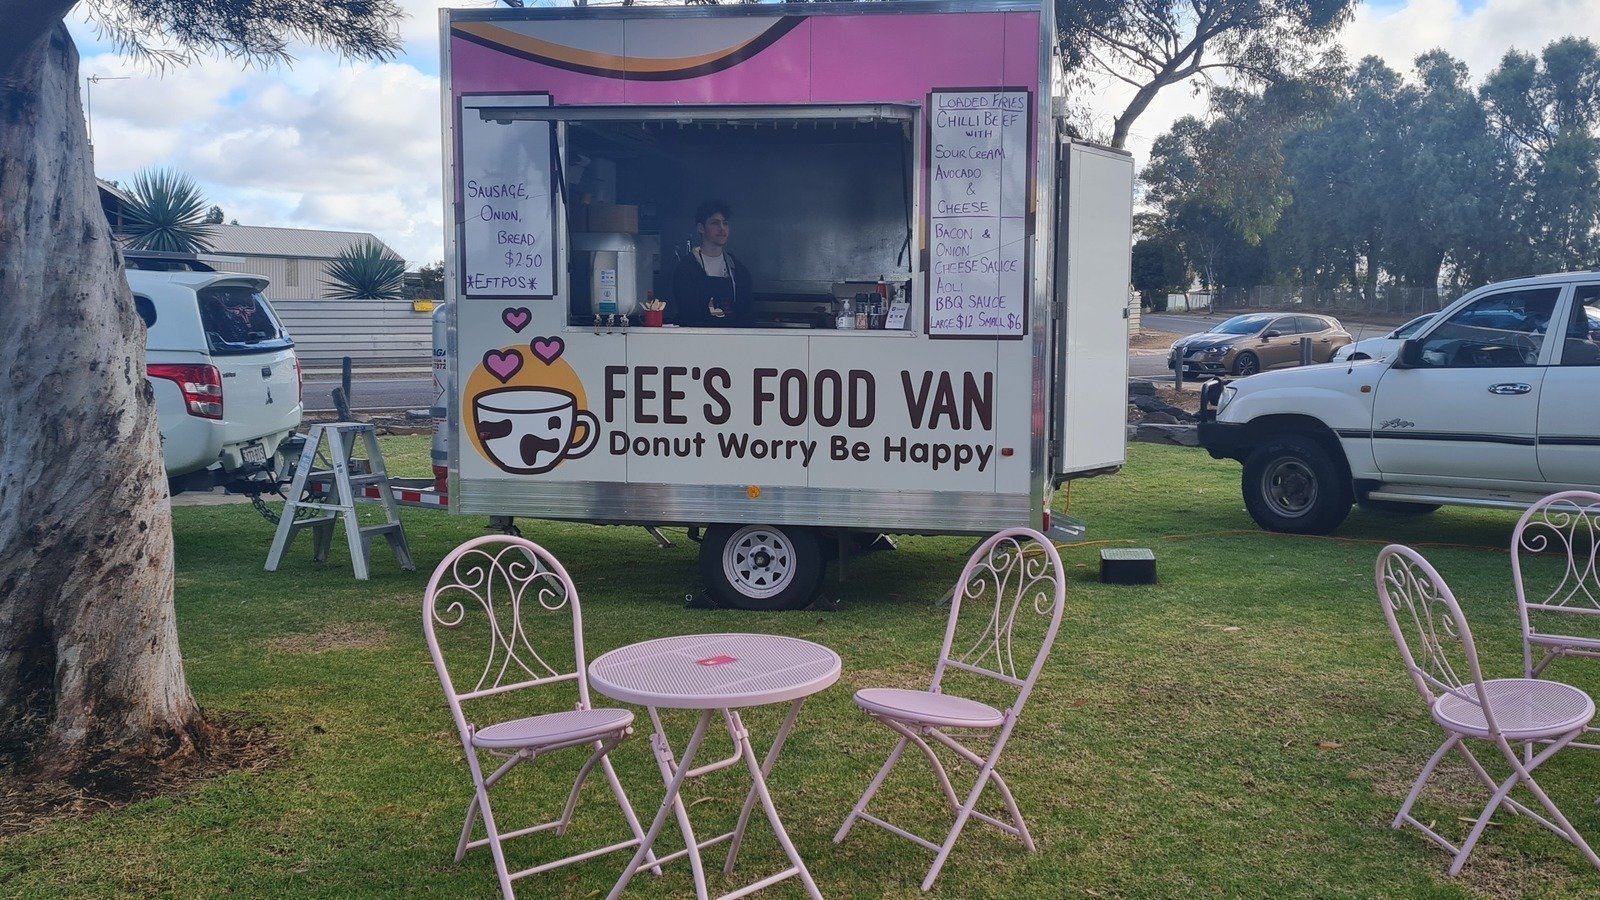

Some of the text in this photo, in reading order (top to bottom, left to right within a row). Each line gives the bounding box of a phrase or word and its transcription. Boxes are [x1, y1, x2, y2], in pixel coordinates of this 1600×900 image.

[939, 93, 1024, 109] LOADED FRIES
[937, 110, 1019, 128] CHILLI BEEF
[965, 130, 992, 138] WITH
[935, 144, 1005, 159] SOUR CREAM
[935, 164, 982, 181] AVOCADO
[467, 180, 530, 200] SAUSAGE,
[966, 182, 976, 195] &
[480, 204, 522, 222] ONION,
[938, 200, 989, 214] CHEESE
[497, 230, 535, 246] BREAD
[935, 223, 991, 239] BACON &
[936, 242, 970, 257] ONION
[504, 250, 543, 268] $2.50
[934, 256, 1018, 275] CHEESE SAUCE
[936, 277, 963, 294] AOLI
[935, 294, 1007, 311] BBQ SAUCE
[930, 311, 1022, 330] LARGE $12 SMALL $6
[604, 365, 993, 431] FEE'S FOOD VAN
[609, 430, 993, 472] Donut Worry Be Happy
